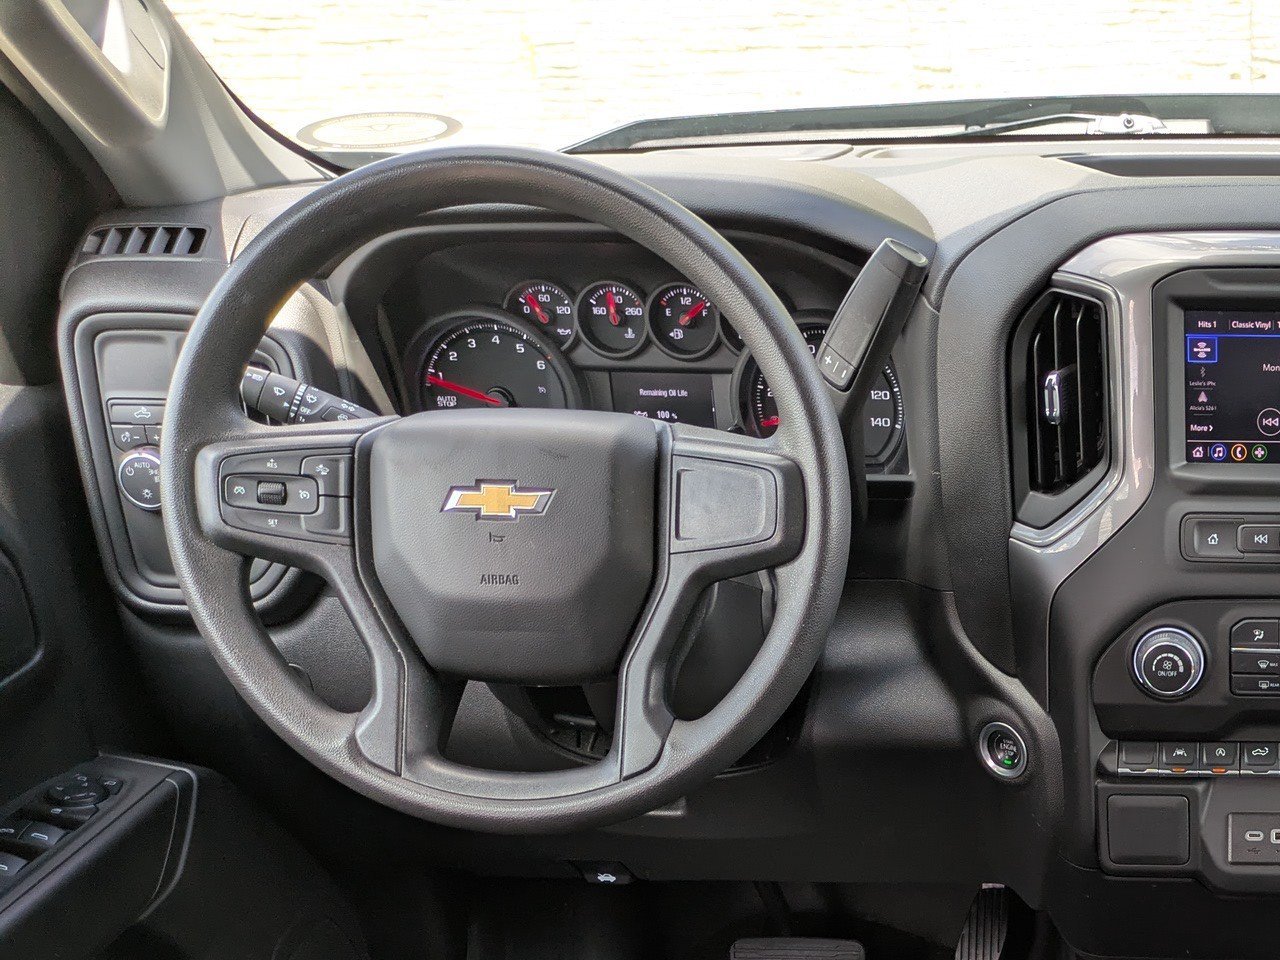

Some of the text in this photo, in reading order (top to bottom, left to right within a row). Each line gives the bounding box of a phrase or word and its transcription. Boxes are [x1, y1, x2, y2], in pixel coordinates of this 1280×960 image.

[538, 294, 550, 302] 60
[523, 306, 531, 314] 0
[556, 306, 571, 315] 120
[592, 306, 607, 315] 160
[625, 307, 642, 316] 260
[665, 309, 671, 317] E
[702, 309, 708, 317] F
[1198, 320, 1211, 328] Hits
[1231, 320, 1271, 330] Classic Vinyl
[467, 338, 476, 348] 3
[491, 335, 500, 345] 4
[516, 343, 525, 354] 5
[449, 351, 458, 361] 2
[536, 360, 546, 370] 6
[639, 388, 688, 397] Remaining Oil Life
[870, 390, 890, 400] 120
[656, 410, 670, 419] 100
[870, 417, 890, 427] 140
[266, 461, 278, 469] RES
[267, 518, 278, 526] SET
[480, 574, 519, 585] AIRBAG
